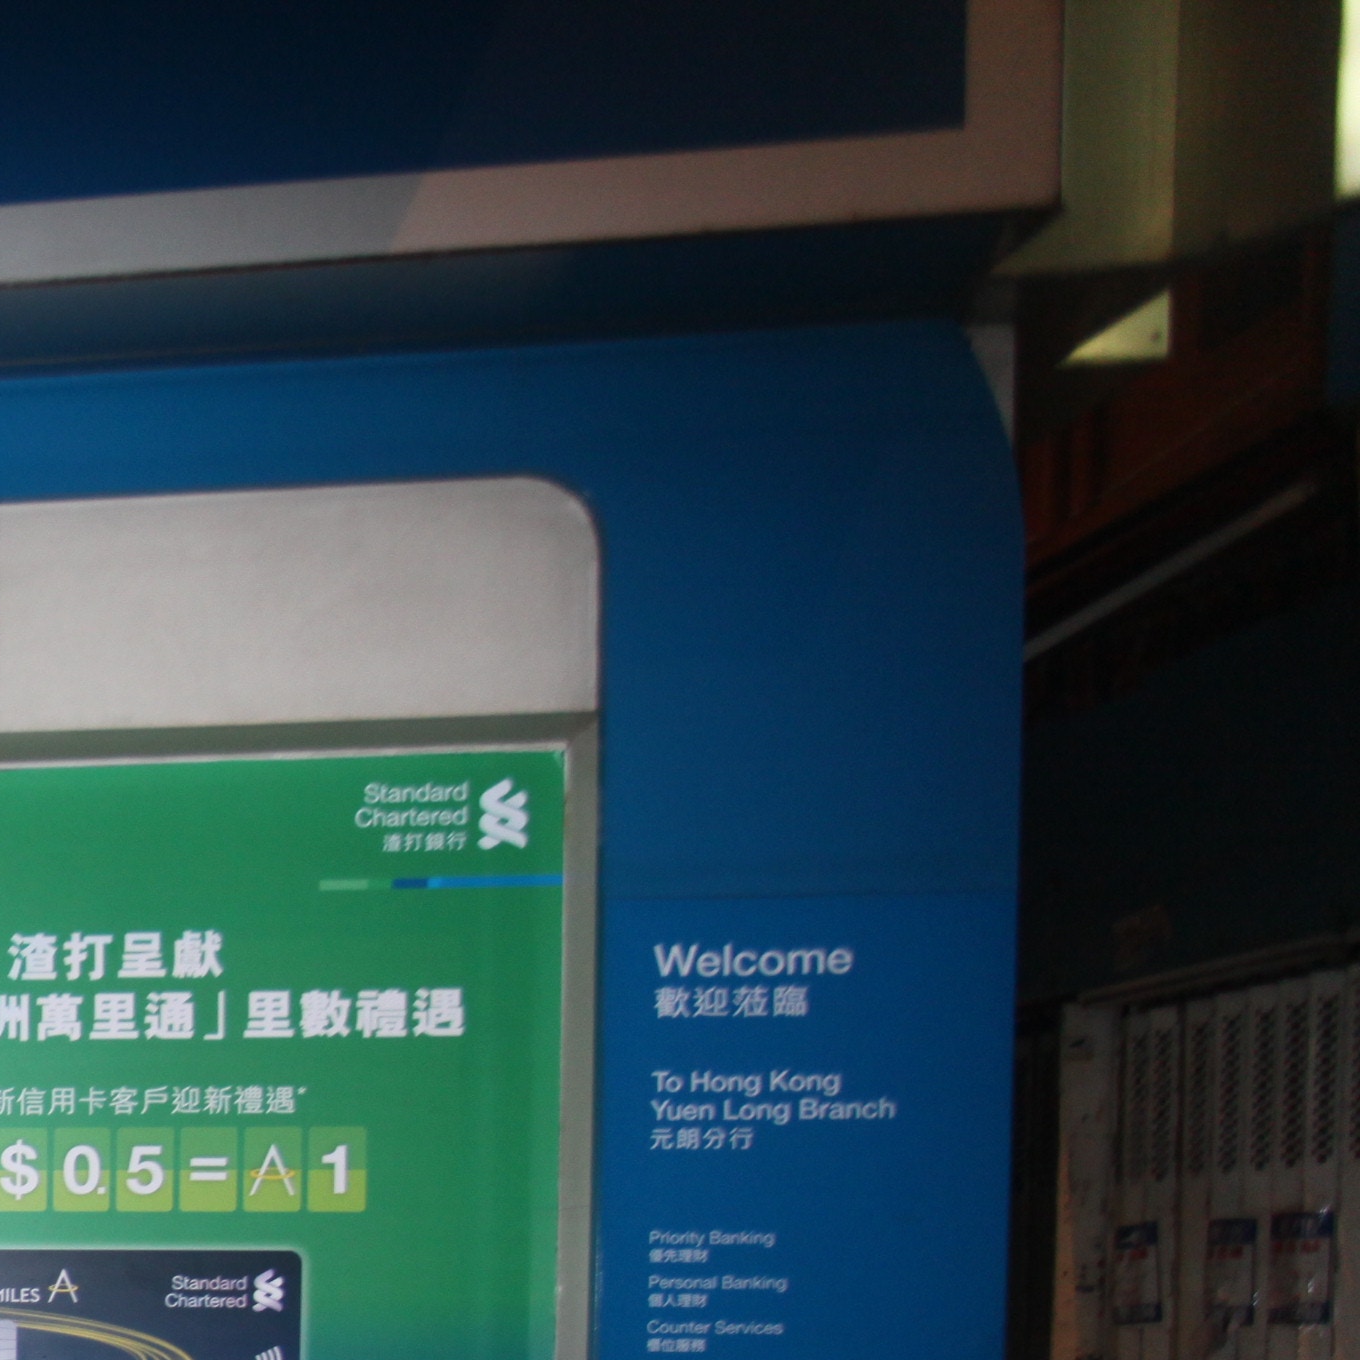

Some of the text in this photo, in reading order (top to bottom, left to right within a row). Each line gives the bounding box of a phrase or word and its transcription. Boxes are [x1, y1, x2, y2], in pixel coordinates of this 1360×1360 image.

[363, 782, 469, 805] Standard
[354, 806, 469, 829] Chartered
[382, 831, 467, 854] 渣打銀行
[7, 932, 224, 981] 渣打呈獻
[653, 943, 853, 977] Welcome
[651, 1070, 841, 1096] To Hong Kong
[650, 1098, 896, 1125] Yuen Long Branch
[649, 1127, 754, 1150] 元朗分行
[649, 1230, 776, 1248] Priority Banking
[171, 1275, 248, 1292] Standard
[648, 1275, 788, 1293] Personal Banking
[164, 1292, 248, 1309] Chartered
[646, 1320, 784, 1335] Counter Services
